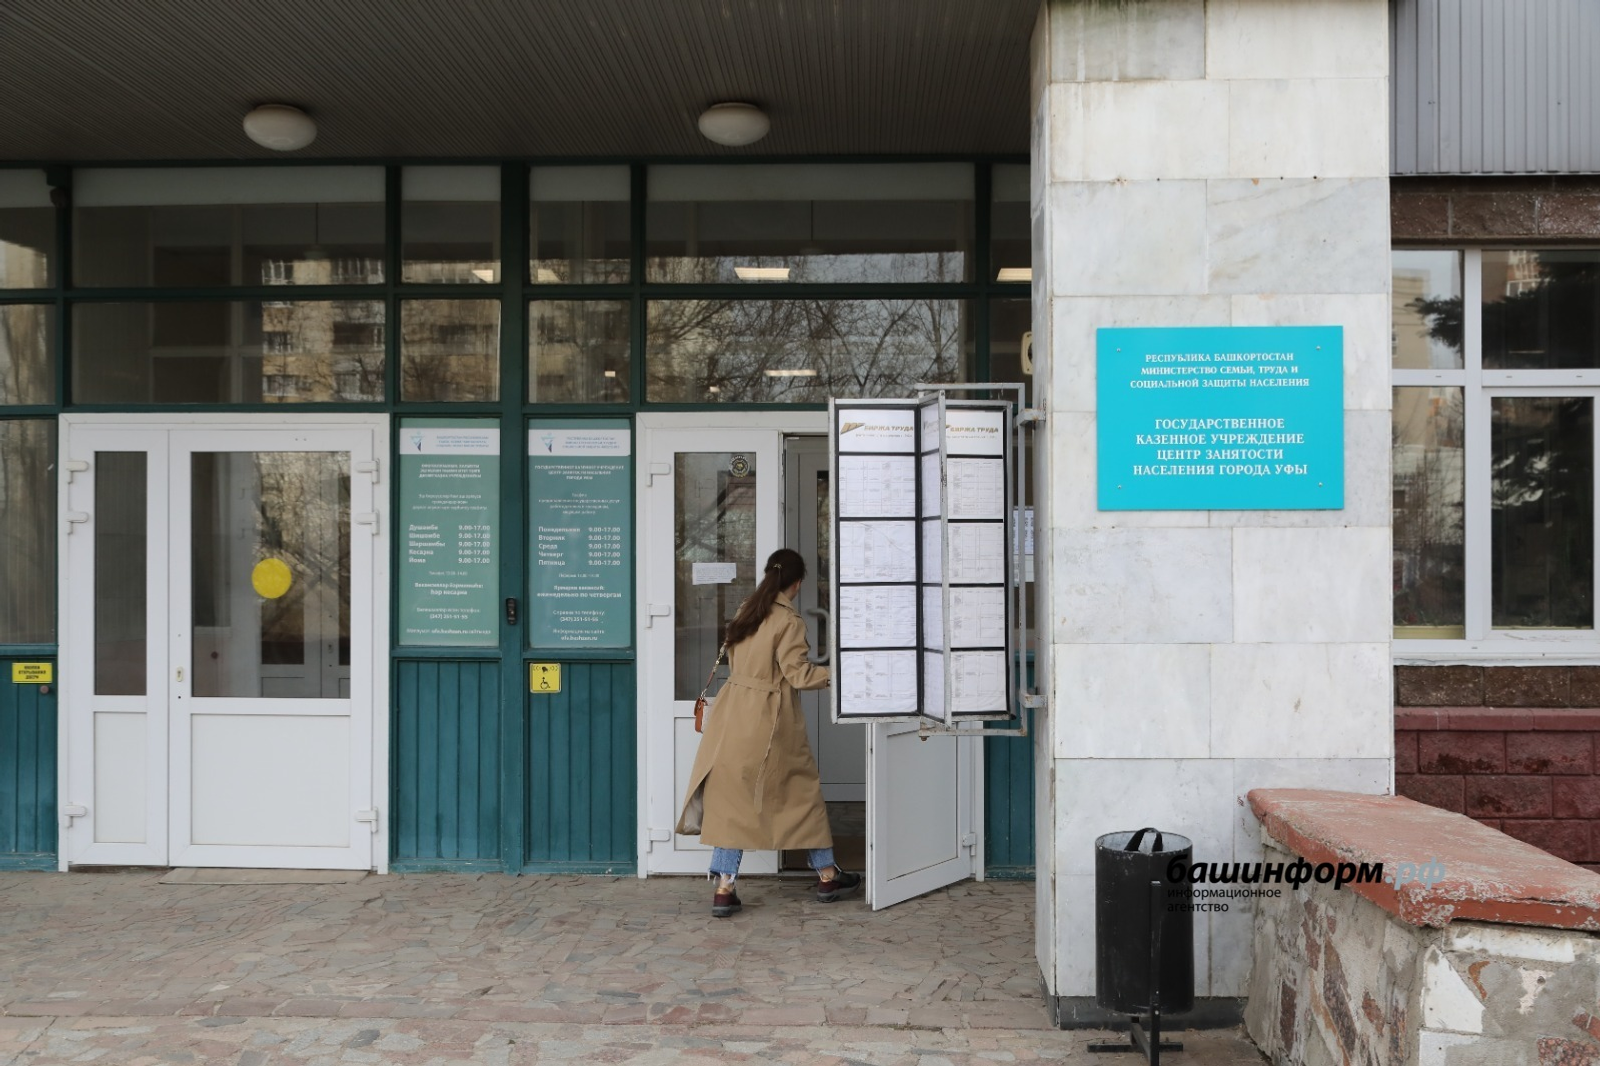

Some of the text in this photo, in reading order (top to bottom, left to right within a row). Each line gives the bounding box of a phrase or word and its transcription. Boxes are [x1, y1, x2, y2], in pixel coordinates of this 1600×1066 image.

[1145, 353, 1294, 363] РЕСПУБЛИКА БАШКОРТОСТАН
[1140, 365, 1298, 376] МИНИСТЕРСТВО СЕМЬИ, ТРУДА И
[1130, 378, 1310, 390] СОЦИАЛЬНОЙ ЗАЩИТЫ НАСЕЛЕНИЯ
[1155, 418, 1285, 431] ГОСУДАРСТВЕННОЕ
[1136, 433, 1305, 446] КАЗЕННОЕ УЧРЕЖДЕНИЕ
[1157, 448, 1284, 462] ЦЕНТР ЗАНЯТОСТИ
[1133, 464, 1308, 477] НАСЕЛЕНИЯ ГОРОДА УФЫ
